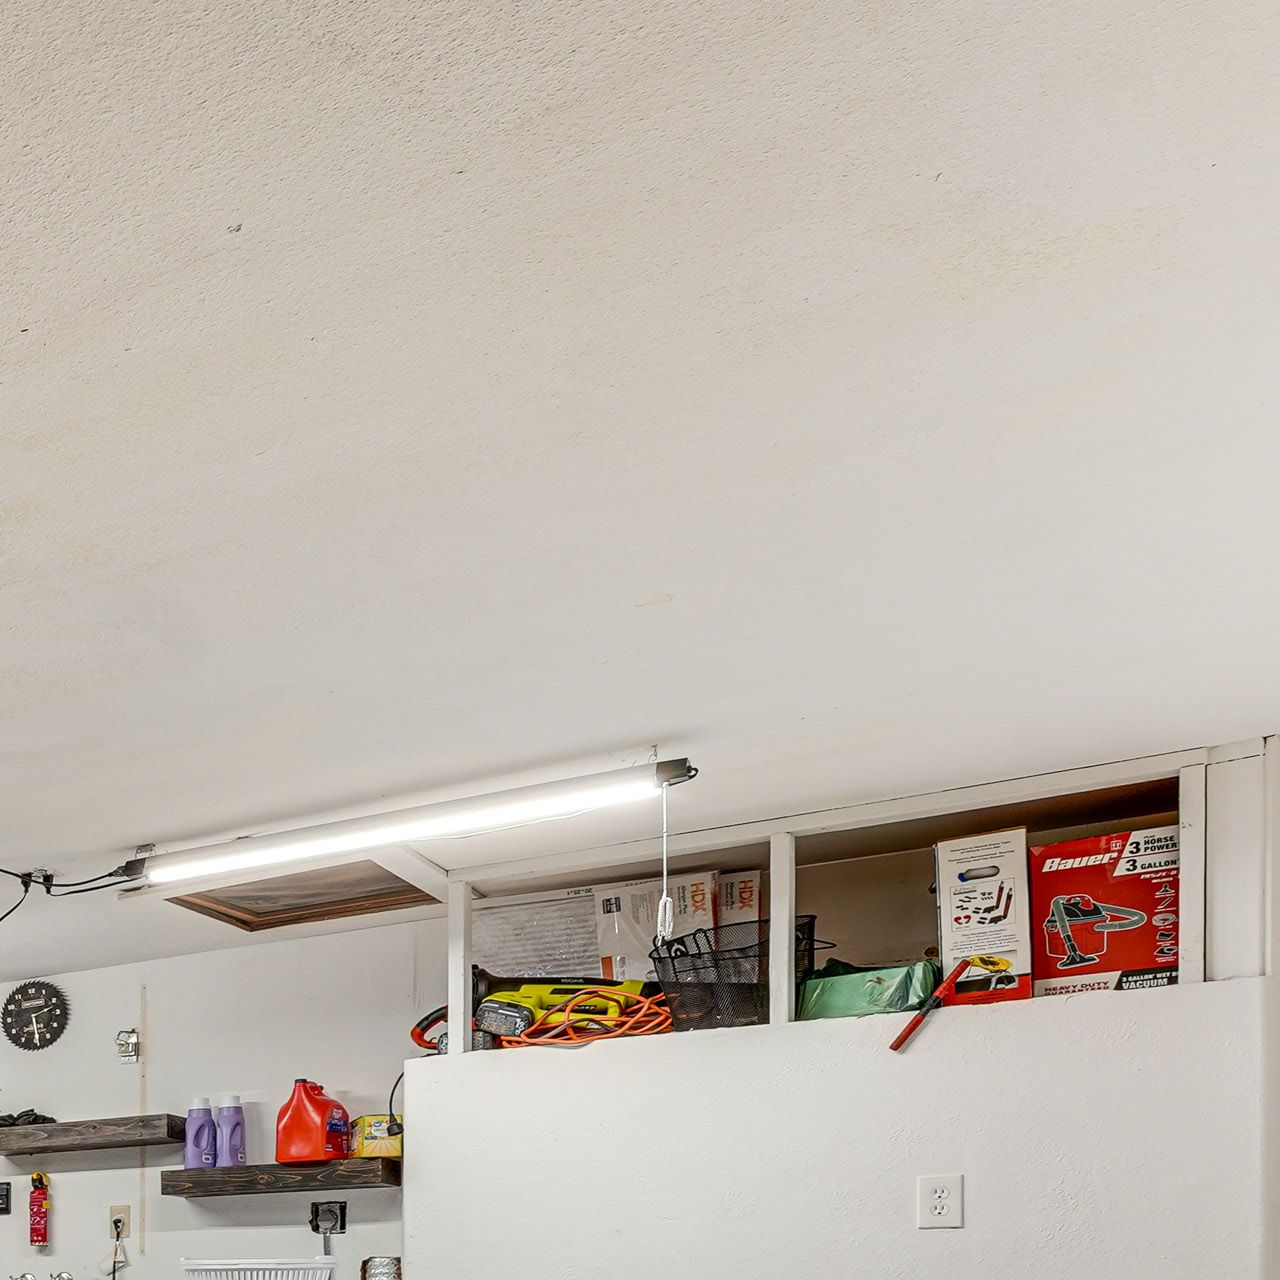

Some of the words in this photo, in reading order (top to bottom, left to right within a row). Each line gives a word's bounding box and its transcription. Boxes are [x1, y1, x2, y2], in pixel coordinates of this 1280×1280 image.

[1144, 836, 1175, 846] HORSE
[1129, 841, 1141, 855] 3
[1144, 843, 1178, 853] POWER
[1041, 852, 1119, 872] Bauer
[1125, 859, 1138, 872] 3
[1141, 860, 1177, 870] GALLON
[690, 882, 706, 914] HDX
[739, 880, 753, 911] HDX
[1044, 984, 1078, 992] HEAVY
[1081, 981, 1109, 989] DUTY
[1122, 978, 1168, 989] VACUUM
